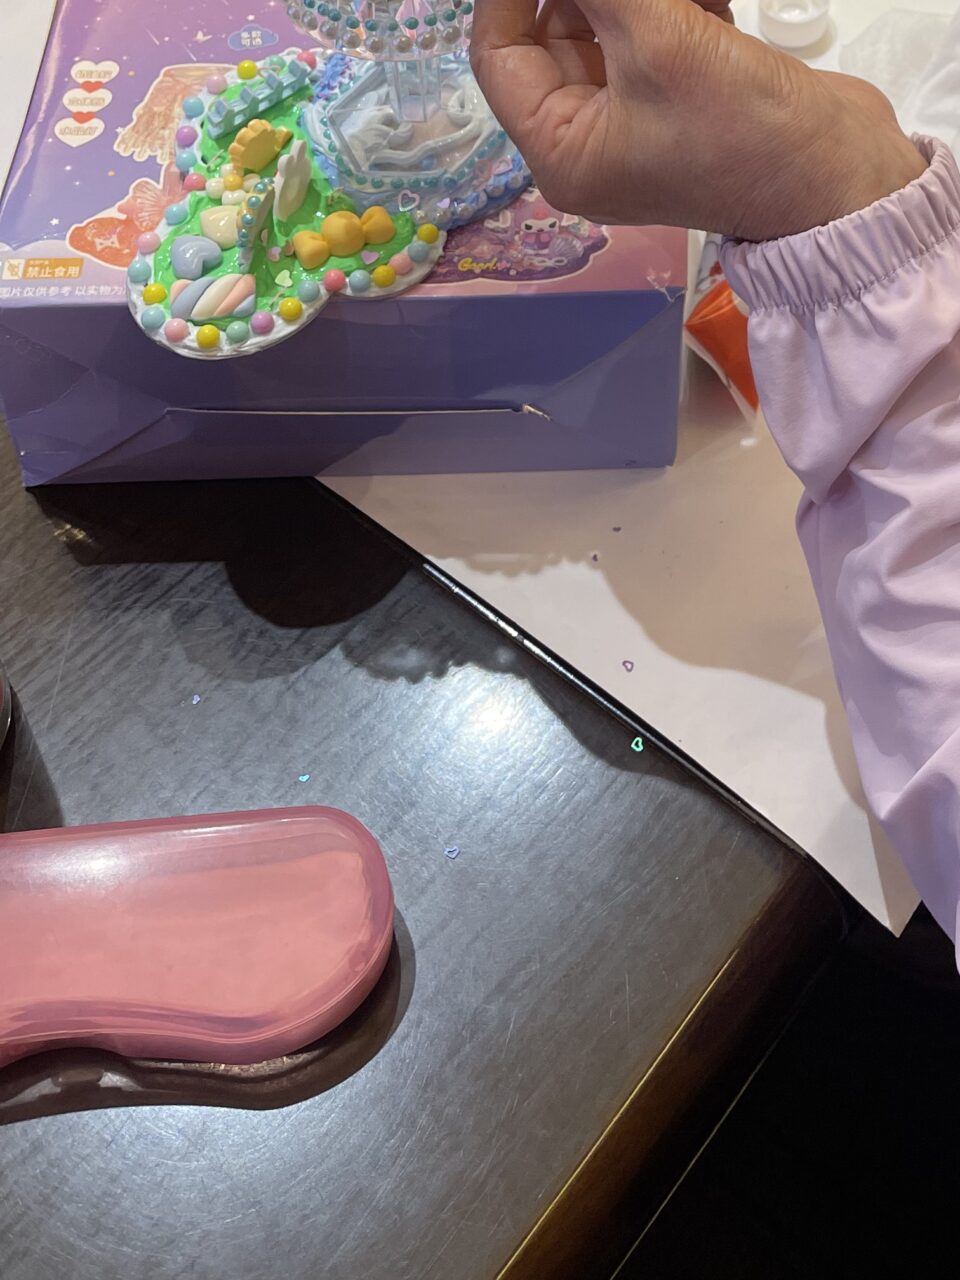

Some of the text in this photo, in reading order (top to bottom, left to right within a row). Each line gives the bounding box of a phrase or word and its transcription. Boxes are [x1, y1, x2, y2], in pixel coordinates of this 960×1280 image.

[25, 265, 81, 278] 禁止食用
[74, 284, 127, 297] 以实物为
